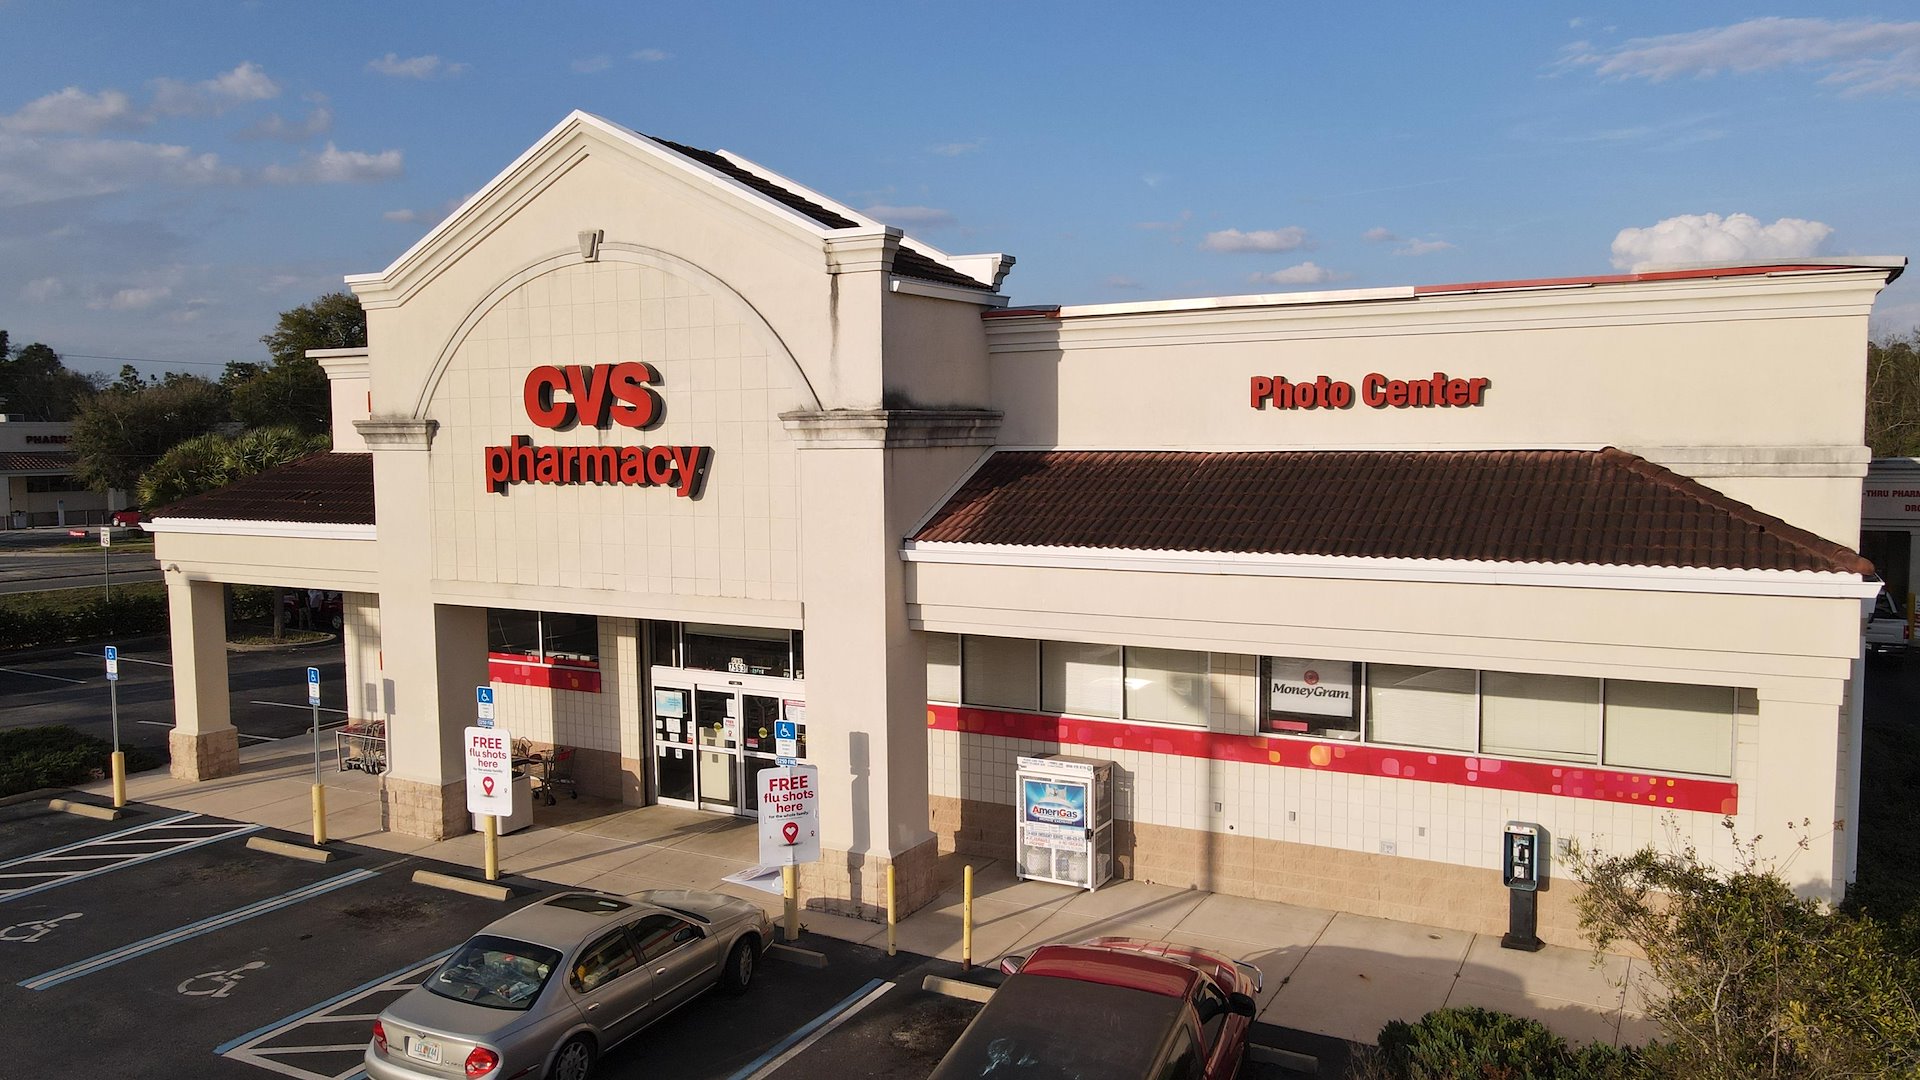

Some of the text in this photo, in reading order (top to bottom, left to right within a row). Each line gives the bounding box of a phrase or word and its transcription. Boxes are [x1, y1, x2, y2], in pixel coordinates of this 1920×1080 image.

[524, 361, 663, 431] CVS
[1250, 373, 1490, 409] Photo Center
[485, 435, 712, 500] pharmacy
[1272, 683, 1351, 699] MoneyGram
[473, 736, 502, 749] FREE
[469, 748, 507, 759] flu shots
[478, 758, 498, 768] here
[769, 775, 808, 791] FREE
[764, 790, 814, 803] flu shots
[776, 803, 803, 813] here
[1032, 805, 1078, 818] AmeriGas
